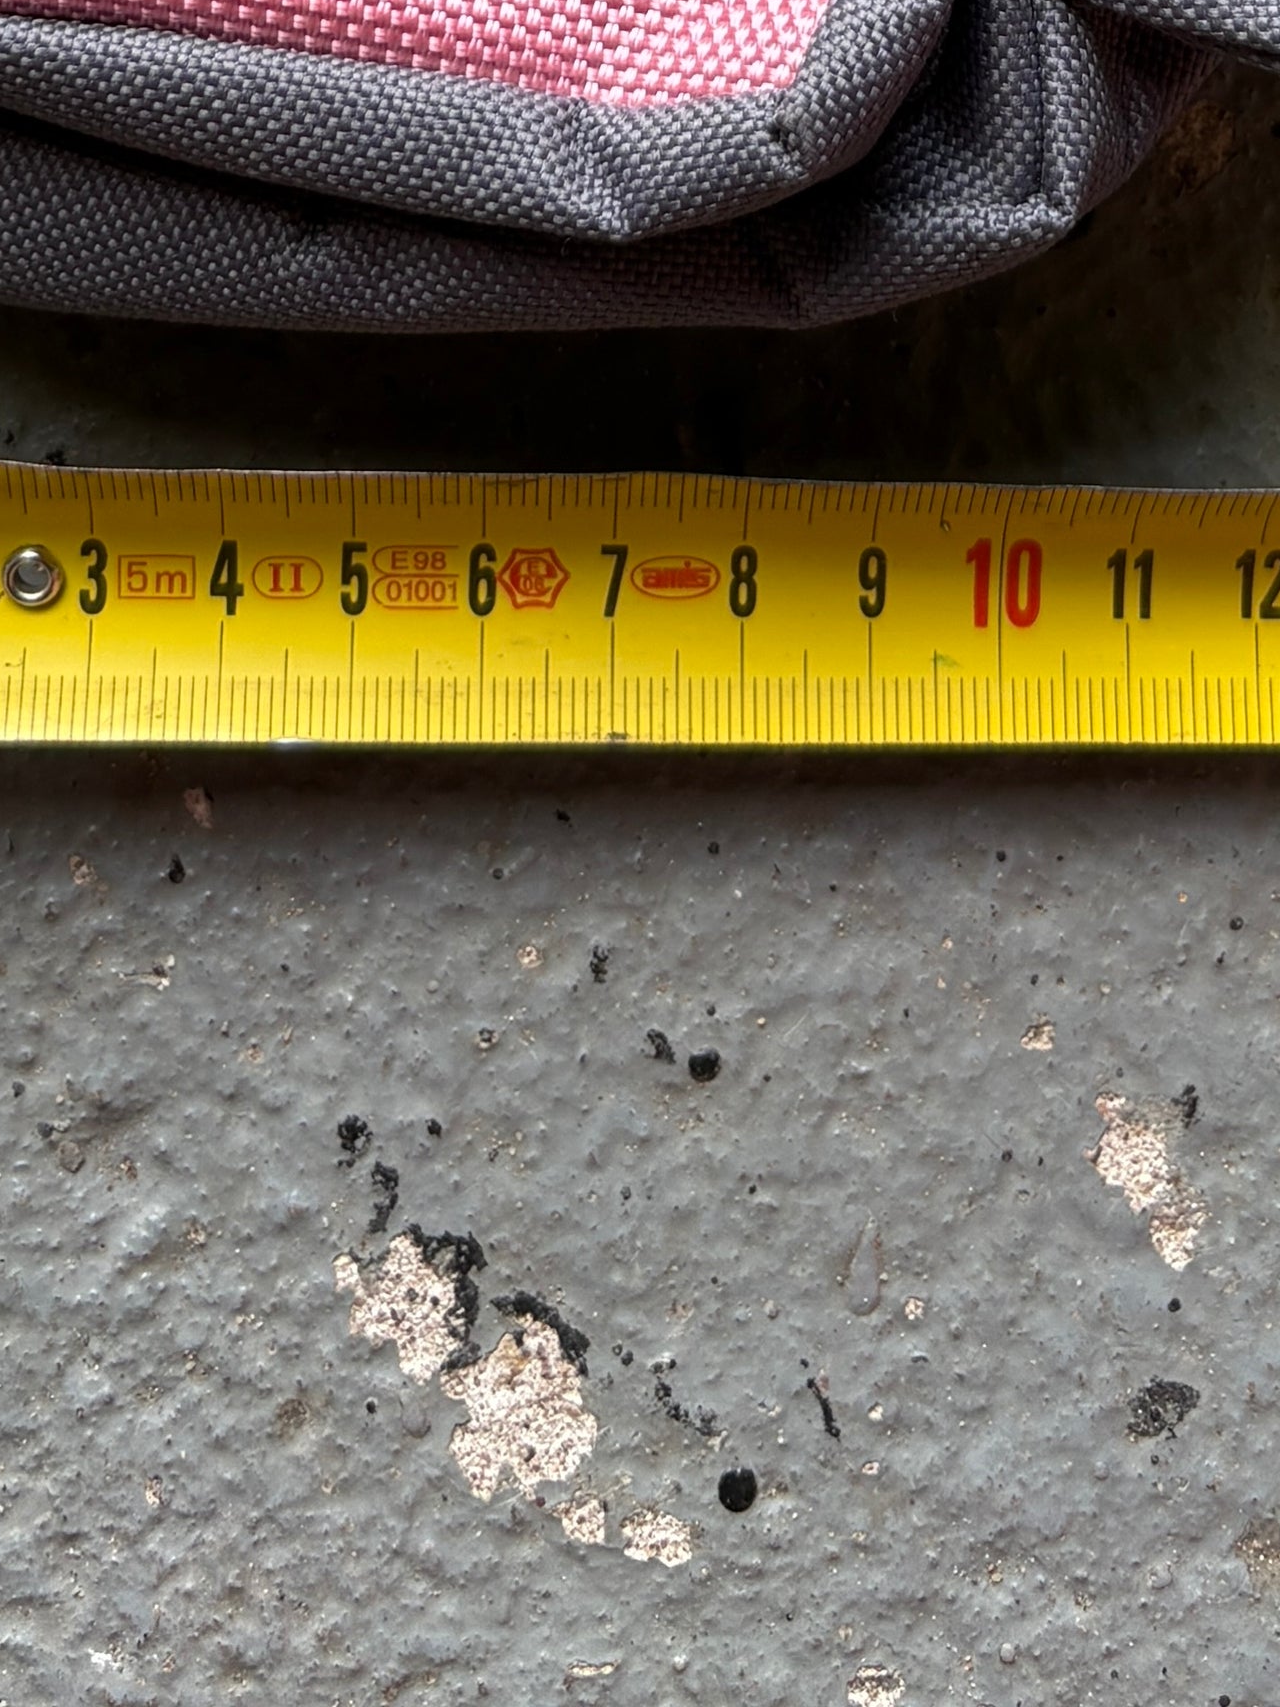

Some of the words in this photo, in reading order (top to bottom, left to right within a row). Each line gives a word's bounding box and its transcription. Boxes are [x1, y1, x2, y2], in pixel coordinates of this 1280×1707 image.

[79, 538, 108, 615] 3
[209, 540, 244, 616] 4
[340, 541, 368, 616] 5
[467, 542, 497, 617] 6
[600, 544, 629, 617] 7
[728, 544, 758, 617] 8
[858, 546, 887, 619] 9
[966, 538, 1043, 628] 10
[1106, 548, 1154, 619] 11
[386, 579, 457, 602] 01001
